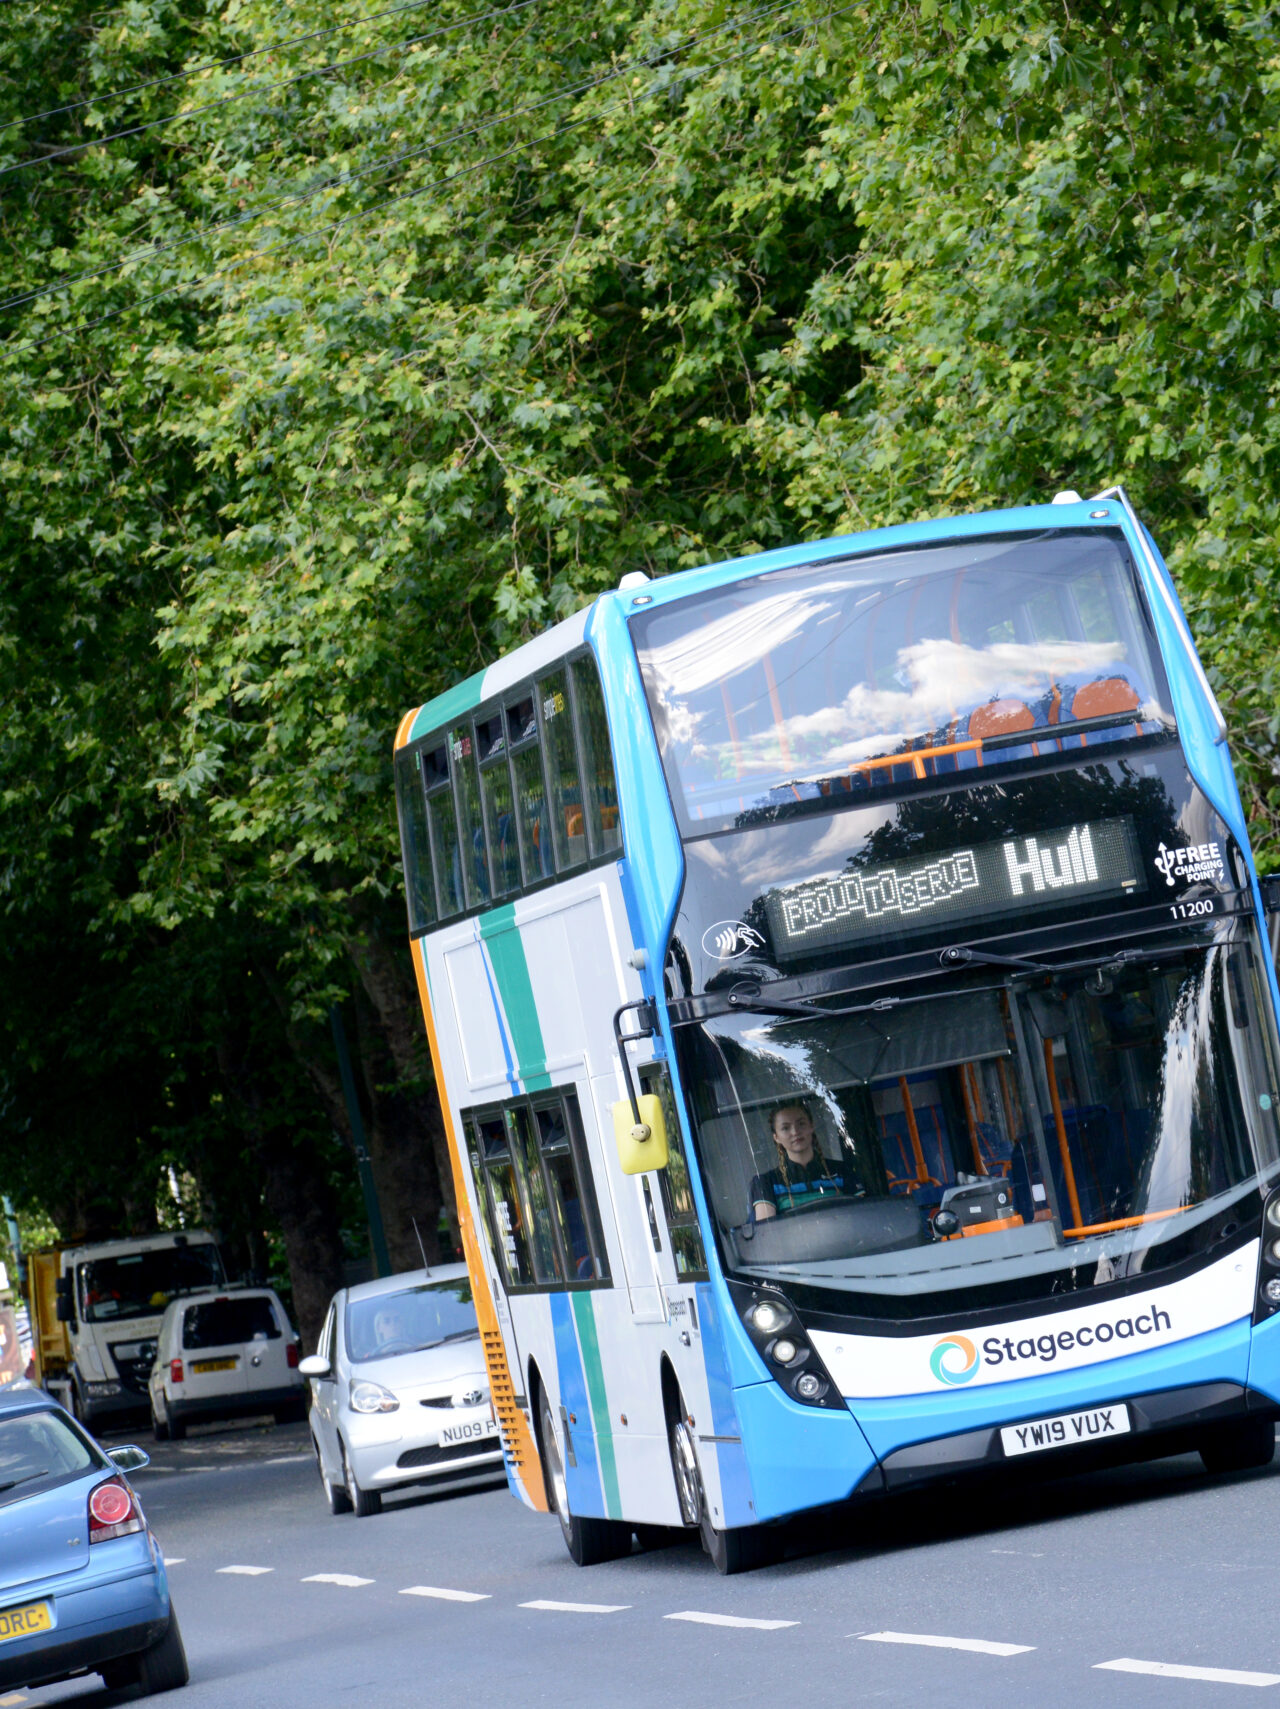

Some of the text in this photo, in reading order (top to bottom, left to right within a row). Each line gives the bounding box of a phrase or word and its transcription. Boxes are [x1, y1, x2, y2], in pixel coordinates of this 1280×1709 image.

[1003, 824, 1099, 896] Hull
[1175, 842, 1221, 865] FREE
[1174, 859, 1224, 876] CHARGING
[1186, 869, 1216, 883] POINT
[787, 857, 974, 929] PROUD TO SERVE
[1170, 899, 1214, 920] 11200
[983, 1304, 1172, 1366] Stagecoach
[443, 1422, 482, 1443] NU09
[1015, 1410, 1115, 1448] YW19 VUX
